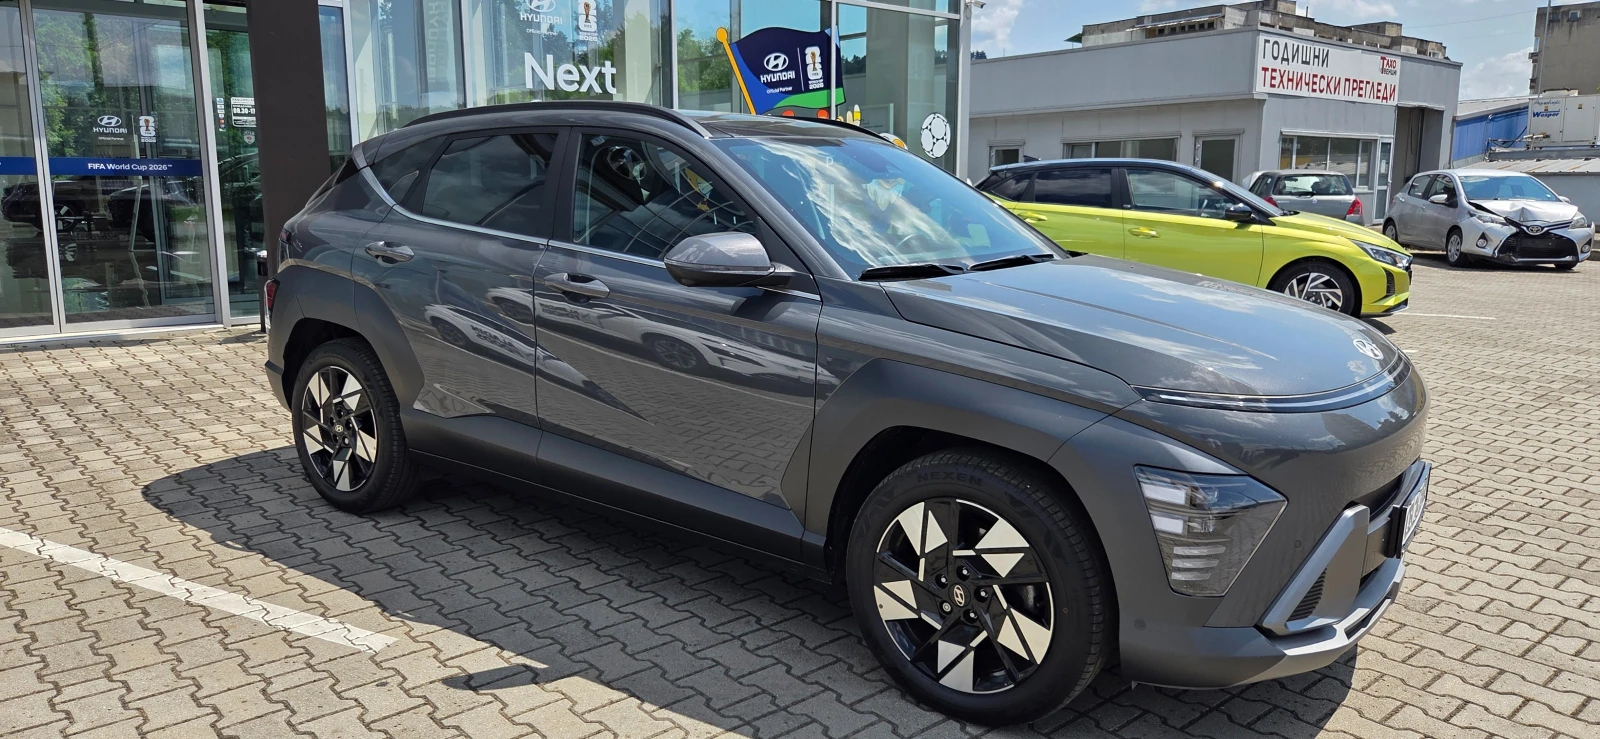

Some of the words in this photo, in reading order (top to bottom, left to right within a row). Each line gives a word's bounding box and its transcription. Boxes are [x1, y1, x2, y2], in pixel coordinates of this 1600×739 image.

[519, 12, 563, 25] HYUNDAI
[1263, 39, 1329, 68] ГОДИШНИ
[524, 52, 617, 94] Next
[760, 70, 795, 83] HYUNDAI
[1262, 67, 1341, 95] ТЕХНИЧЕСКИ
[1343, 77, 1396, 103] ПРЕГЛЕДИ
[131, 163, 148, 171] Cup
[917, 471, 983, 487] NEXEN
